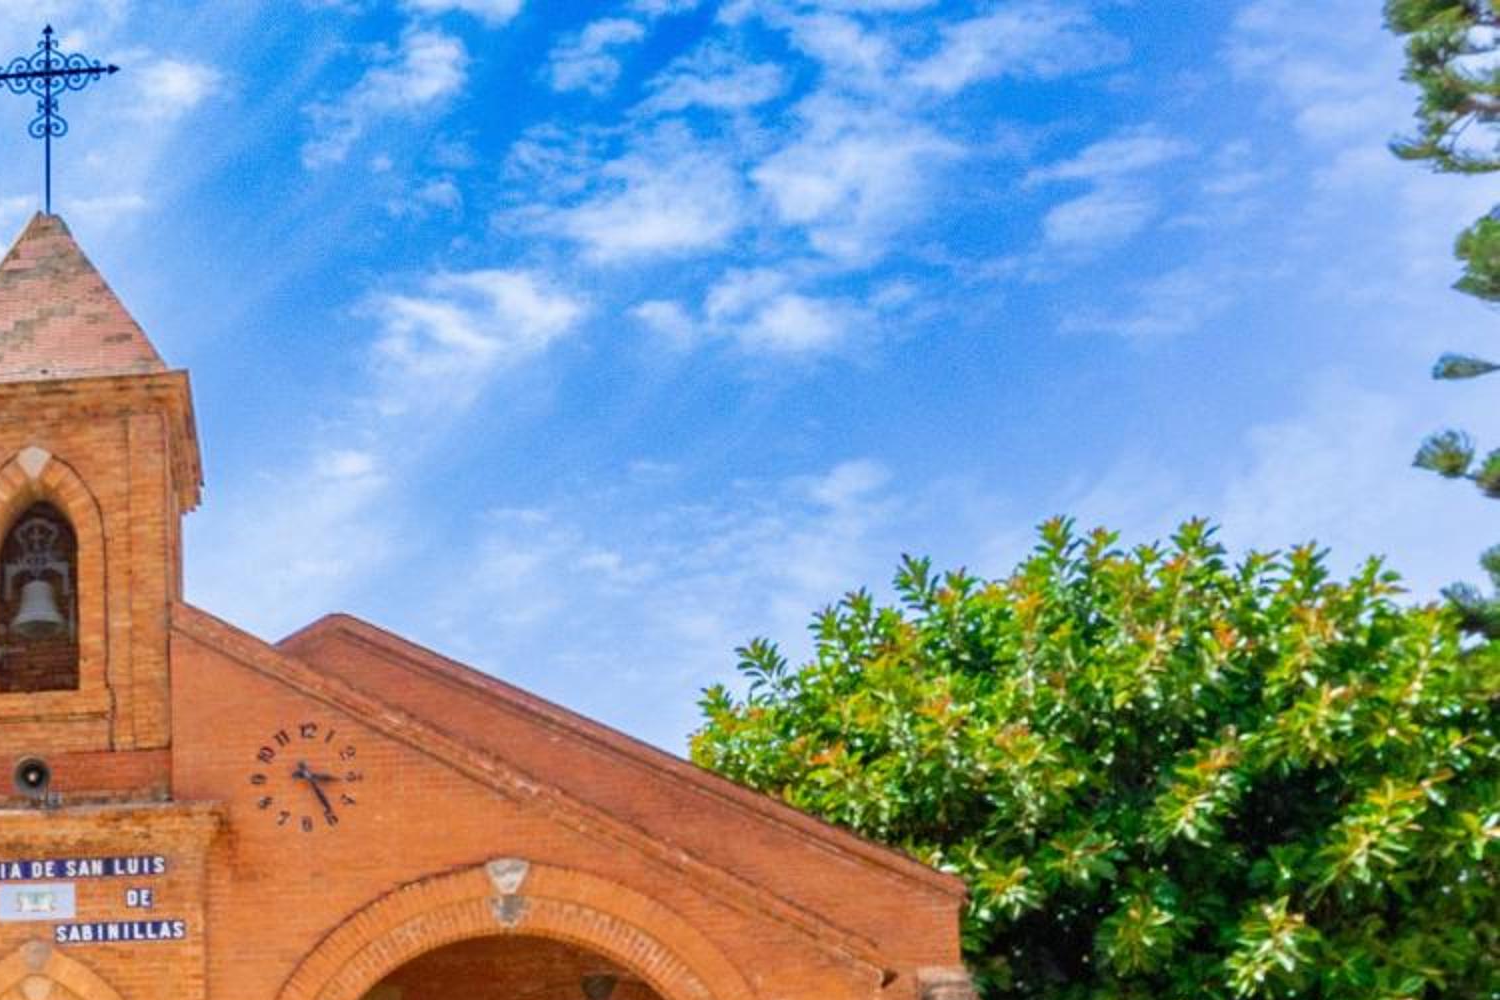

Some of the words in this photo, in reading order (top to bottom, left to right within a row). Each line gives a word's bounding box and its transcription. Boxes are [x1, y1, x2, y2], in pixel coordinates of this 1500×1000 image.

[300, 722, 317, 739] 12
[31, 861, 55, 877] DE
[66, 859, 102, 876] SAN
[114, 857, 165, 875] LUIS
[126, 889, 151, 907] DE
[56, 921, 184, 942] SABINILLAS
